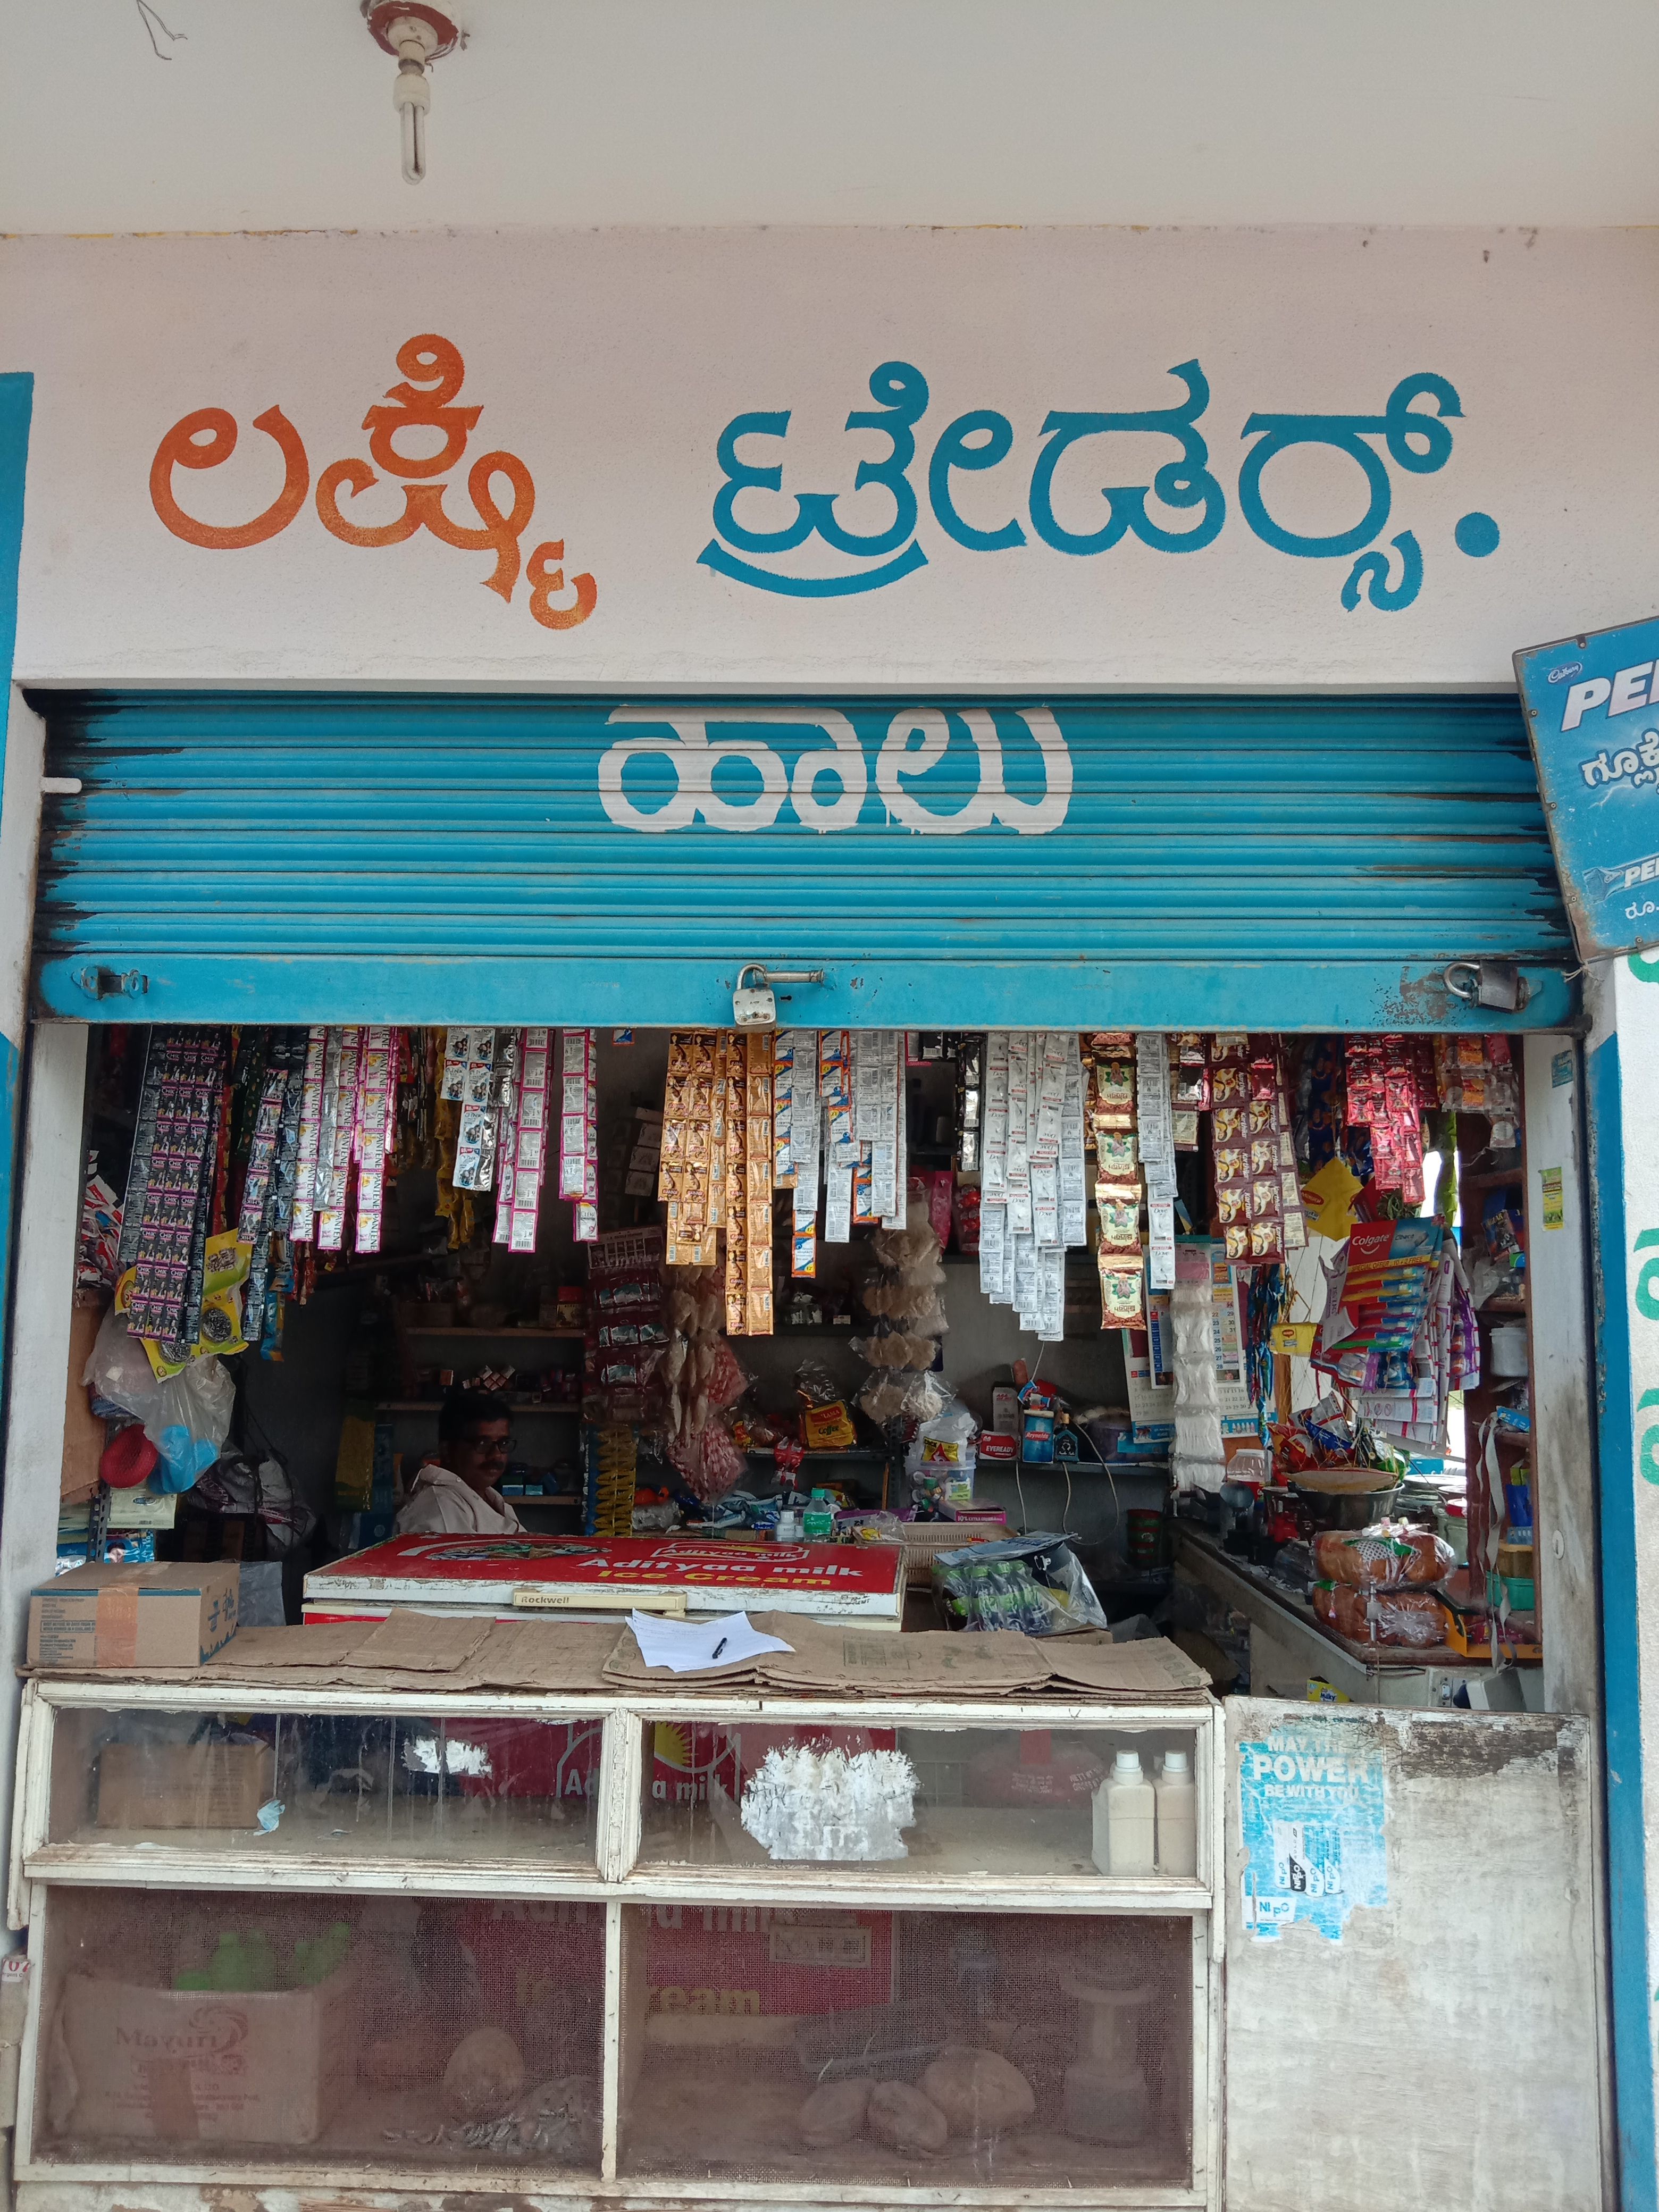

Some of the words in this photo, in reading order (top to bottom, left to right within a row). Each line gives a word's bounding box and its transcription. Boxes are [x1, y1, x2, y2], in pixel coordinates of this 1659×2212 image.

[1548, 661, 1582, 683] Cadbury
[598, 706, 1074, 835] ಹಾಲು
[1624, 857, 1659, 888] PE
[347, 1051, 356, 1087] PANTENE
[344, 1090, 353, 1125] PANTENE
[309, 1122, 318, 1160] PANTENE
[340, 1131, 350, 1167] PANTENE
[375, 1133, 384, 1168] PANTENE
[307, 1162, 316, 1198] PANTENE
[337, 1170, 346, 1205] PANTENE
[373, 1173, 381, 1209] PANTENE
[333, 1210, 342, 1246] PANTENE
[1352, 1234, 1389, 1246] Colgate
[819, 1425, 839, 1435] Coffee
[664, 1548, 748, 1557] Adityaa
[576, 1558, 756, 1572] Adityaa
[773, 1565, 863, 1577] milk
[598, 1570, 668, 1579] Ice
[684, 1573, 832, 1585] Cream
[521, 1596, 569, 1604] Rockwell
[1267, 1736, 1307, 1752] MAY
[1253, 1755, 1369, 1782] POWER
[1265, 1784, 1284, 1797] BE
[1286, 1785, 1325, 1798] WITH
[1326, 1786, 1359, 1799] YOU
[1292, 1865, 1303, 1889] NIPPO
